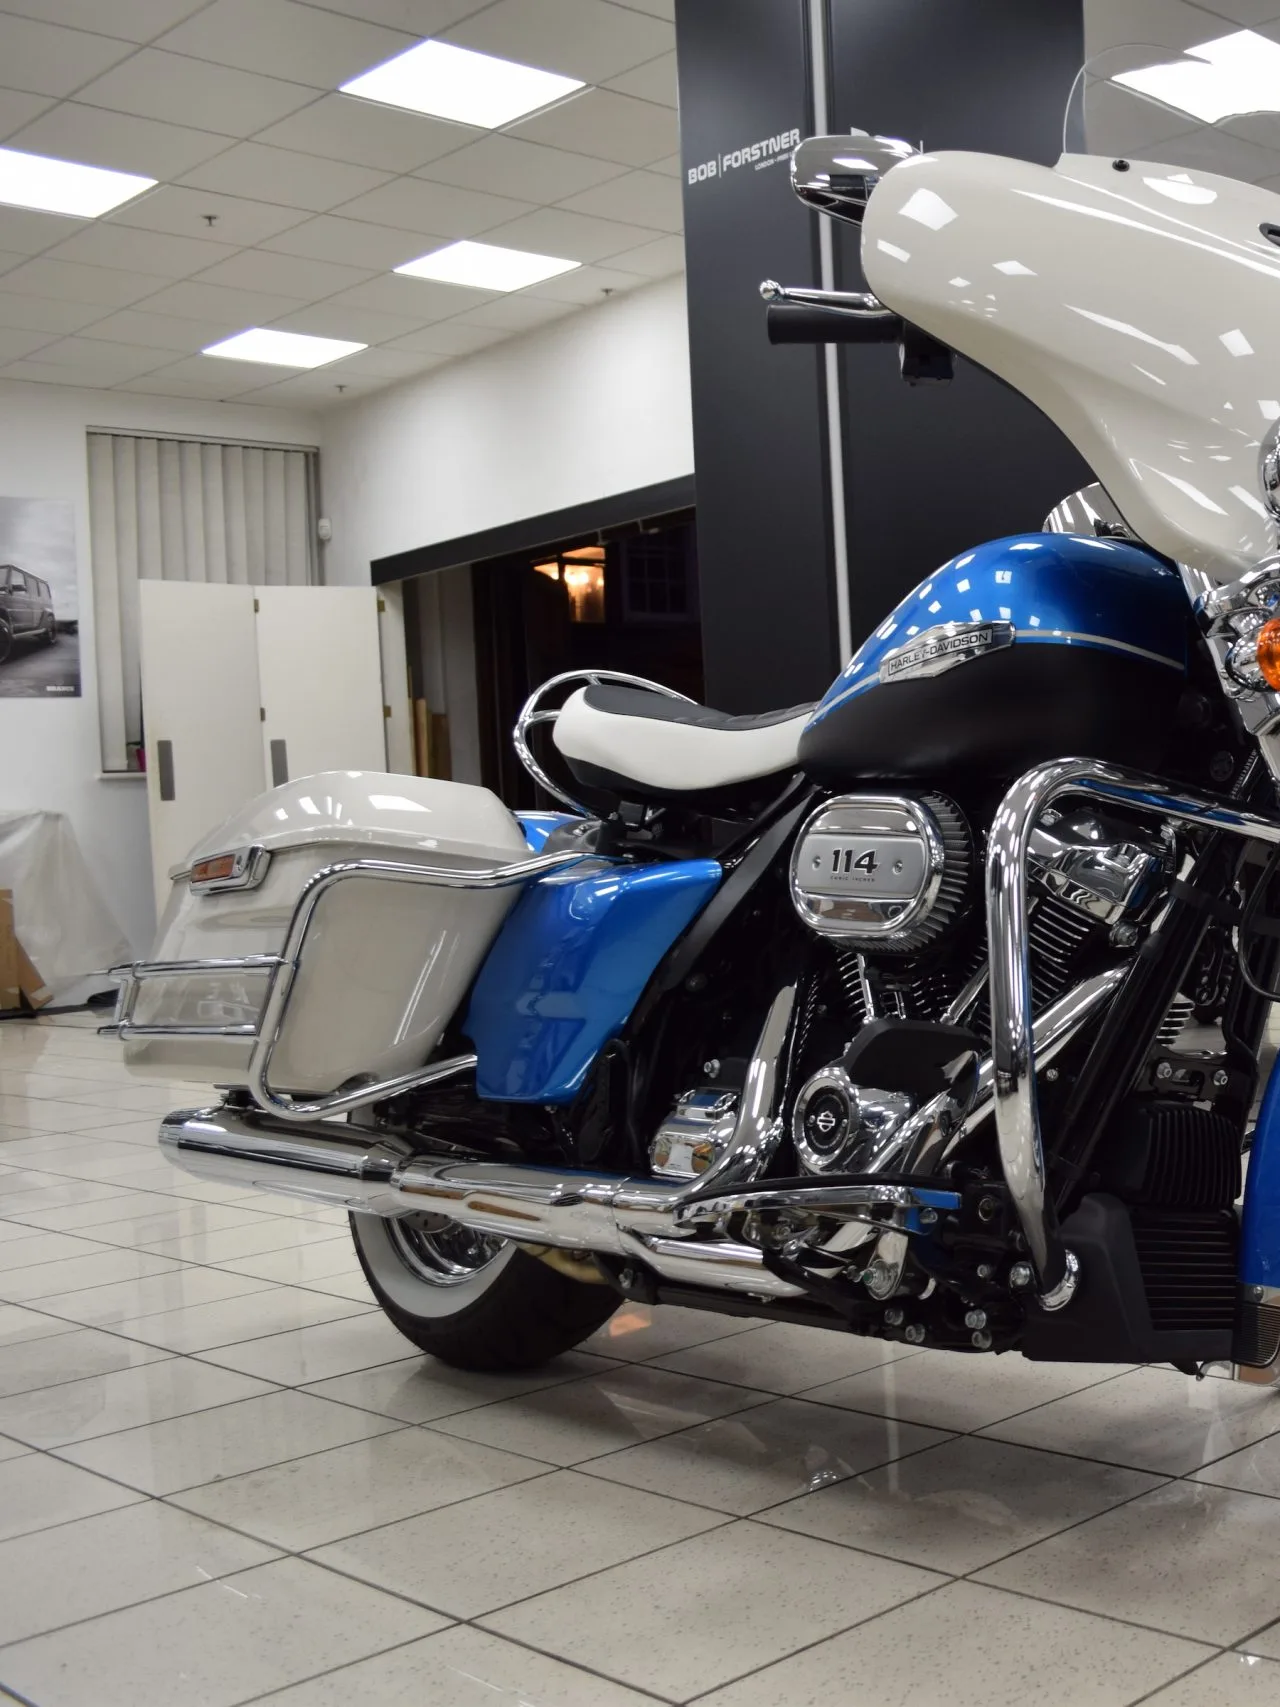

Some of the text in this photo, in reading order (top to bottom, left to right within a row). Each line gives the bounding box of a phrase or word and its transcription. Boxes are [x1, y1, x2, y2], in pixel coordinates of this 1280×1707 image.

[687, 128, 800, 185] BOB FORSTNER
[890, 632, 989, 671] HARLEY-DAVIDSON
[832, 848, 878, 875] 114
